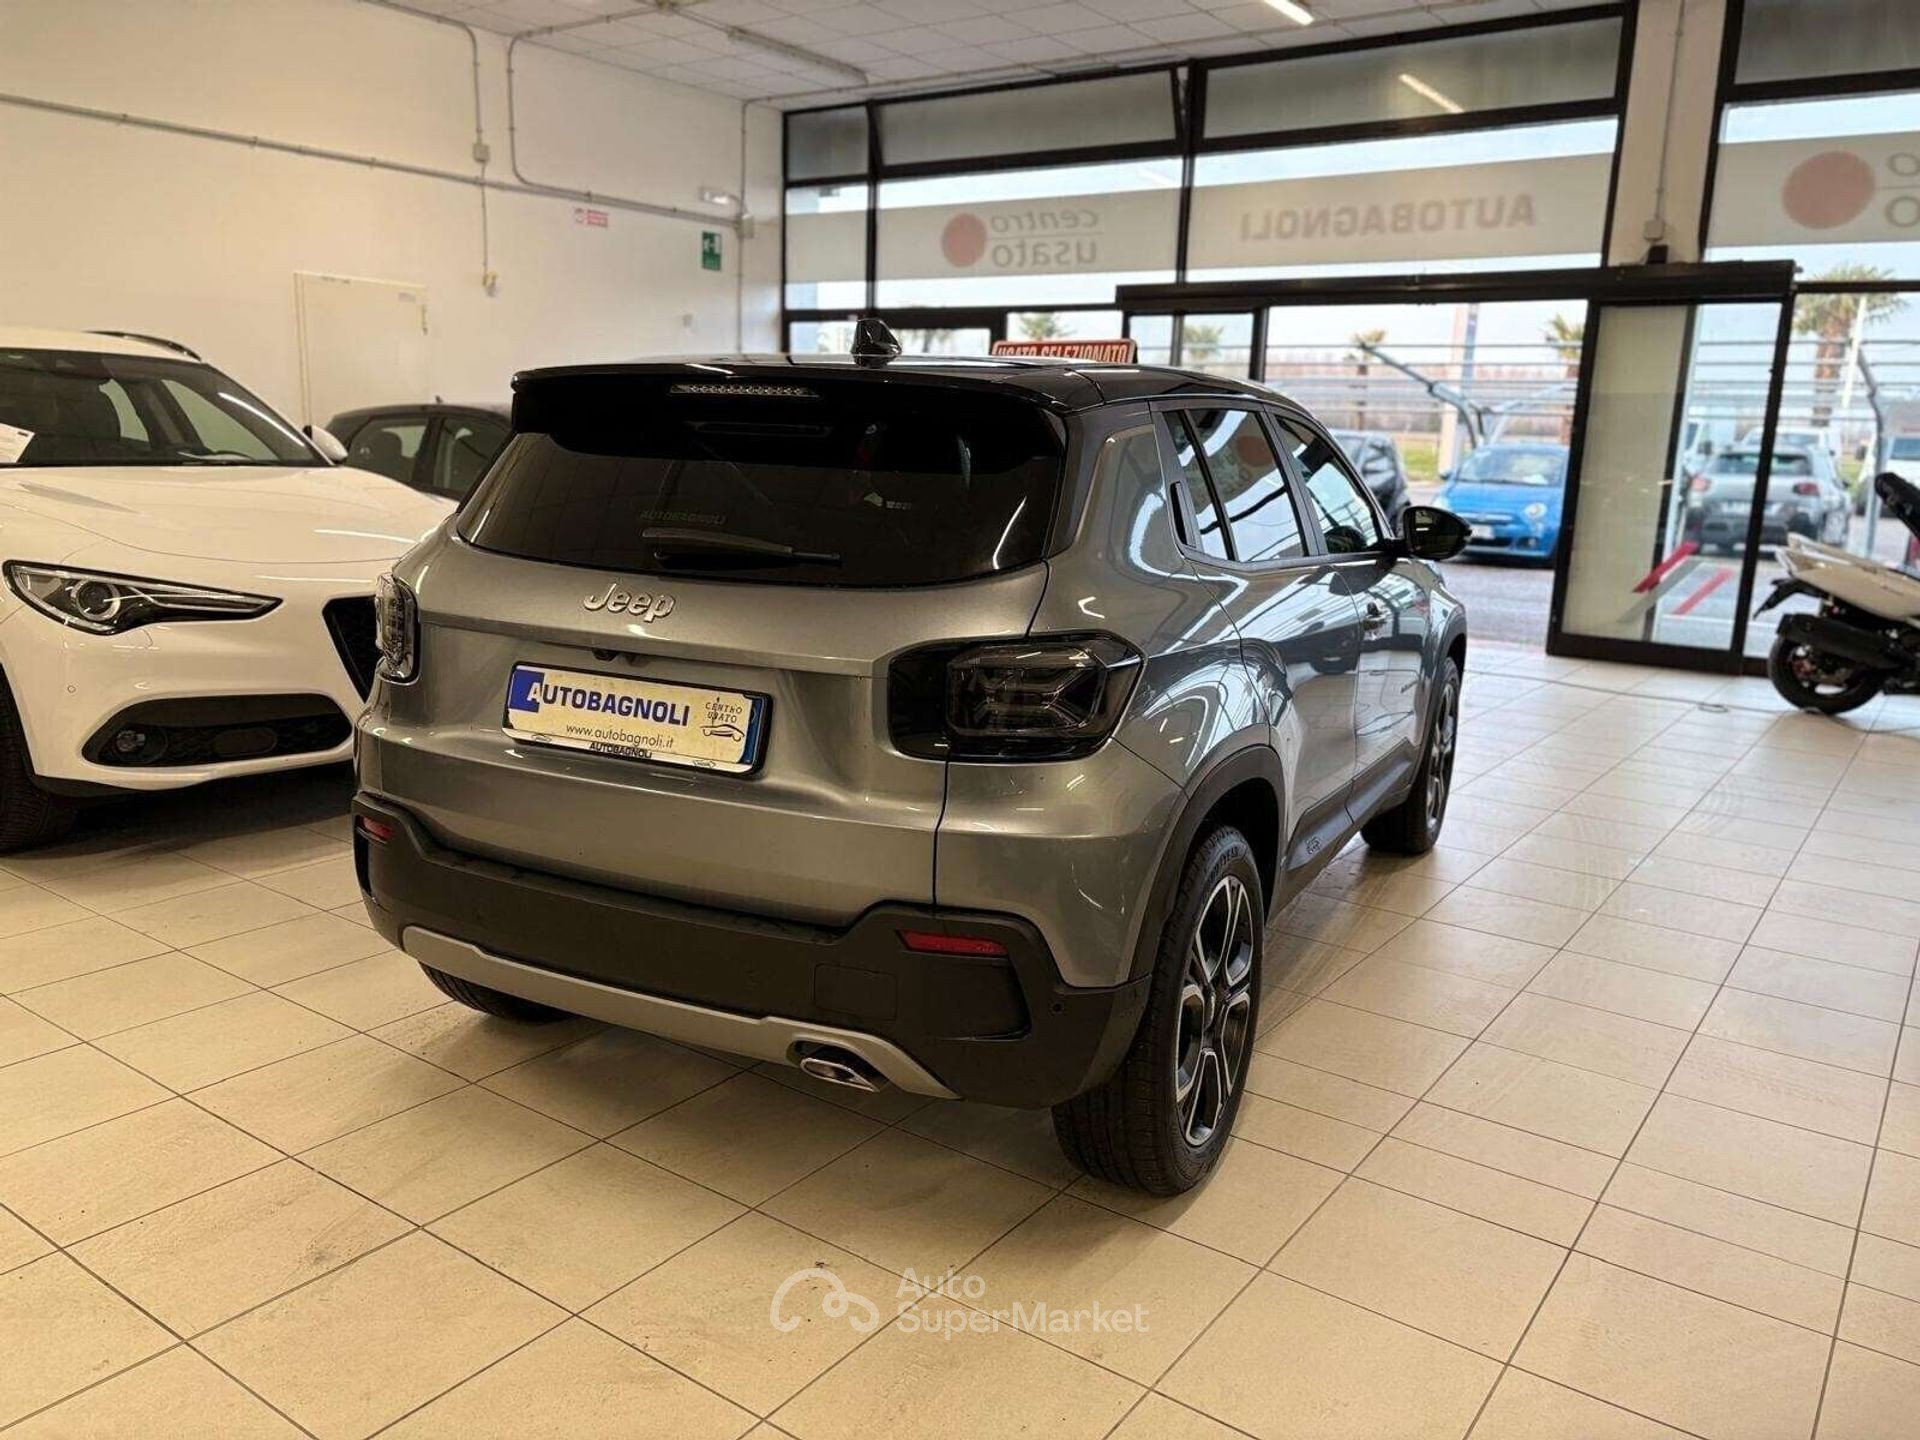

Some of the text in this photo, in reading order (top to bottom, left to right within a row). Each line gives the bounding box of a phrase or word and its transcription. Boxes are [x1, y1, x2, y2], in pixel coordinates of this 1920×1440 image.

[583, 583, 676, 623] Jeep
[526, 681, 690, 727] AUTOBAGNOLI
[566, 724, 674, 749] www.autobagnoli.it
[589, 740, 653, 759] AUTOBAGNOLI
